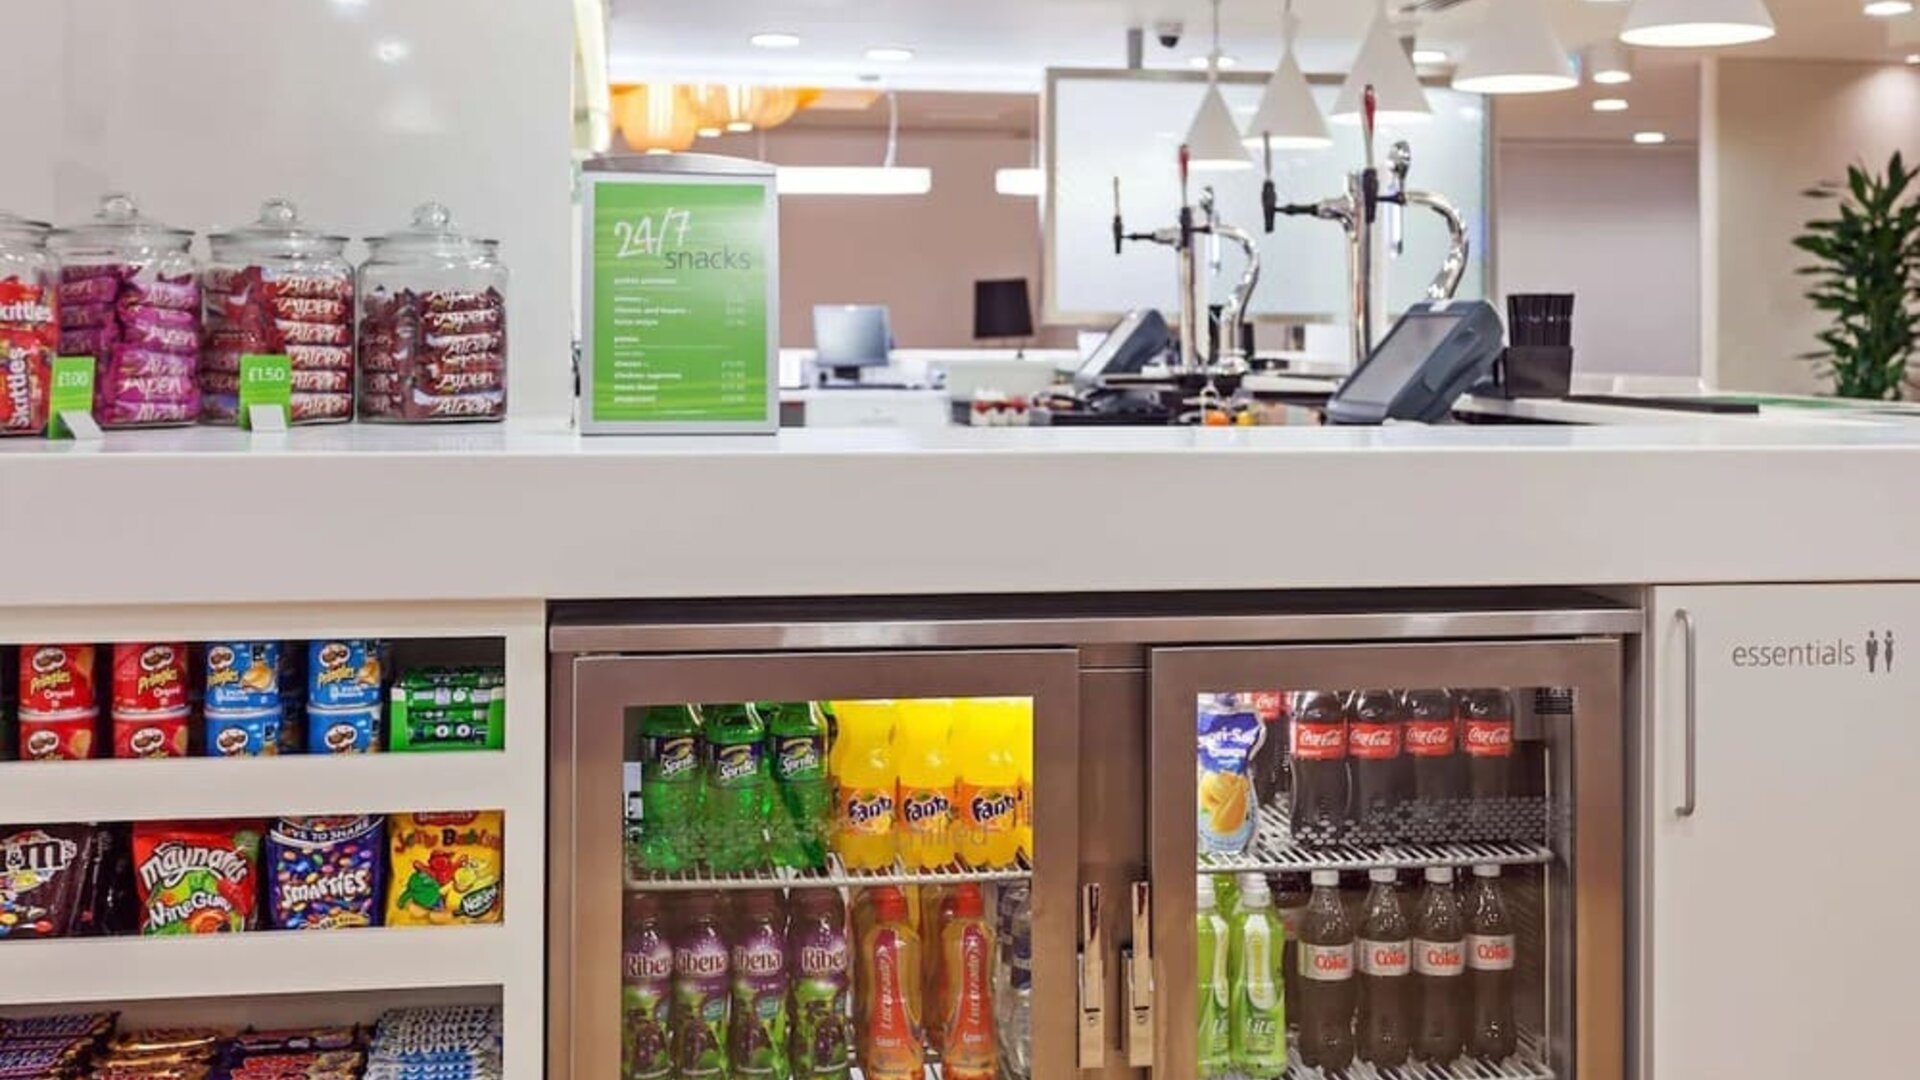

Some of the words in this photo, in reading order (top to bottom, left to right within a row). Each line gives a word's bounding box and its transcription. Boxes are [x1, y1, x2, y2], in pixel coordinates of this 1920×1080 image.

[614, 207, 691, 258] 24/7
[664, 246, 751, 270] snacks
[0, 300, 54, 322] kittles
[1732, 638, 1856, 667] essentials
[971, 794, 1017, 823] Fant
